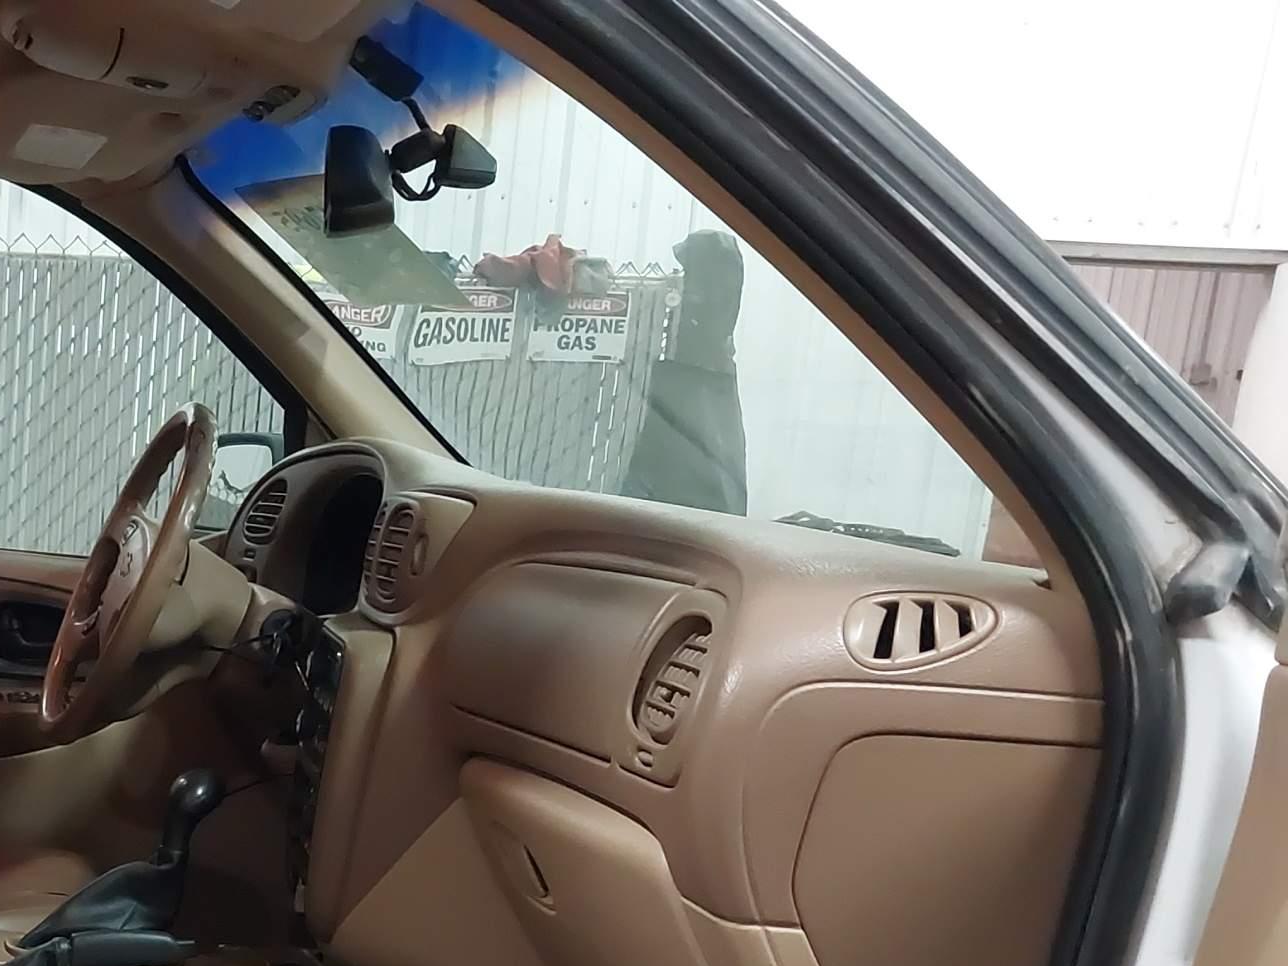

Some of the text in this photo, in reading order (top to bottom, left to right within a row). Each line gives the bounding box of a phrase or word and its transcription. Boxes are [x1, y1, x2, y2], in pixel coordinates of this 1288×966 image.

[468, 294, 498, 307] GER
[568, 297, 611, 311] NGER
[331, 304, 386, 323] ANGER
[346, 326, 362, 337] O
[414, 317, 512, 348] GASOLINE
[557, 334, 597, 351] GAS
